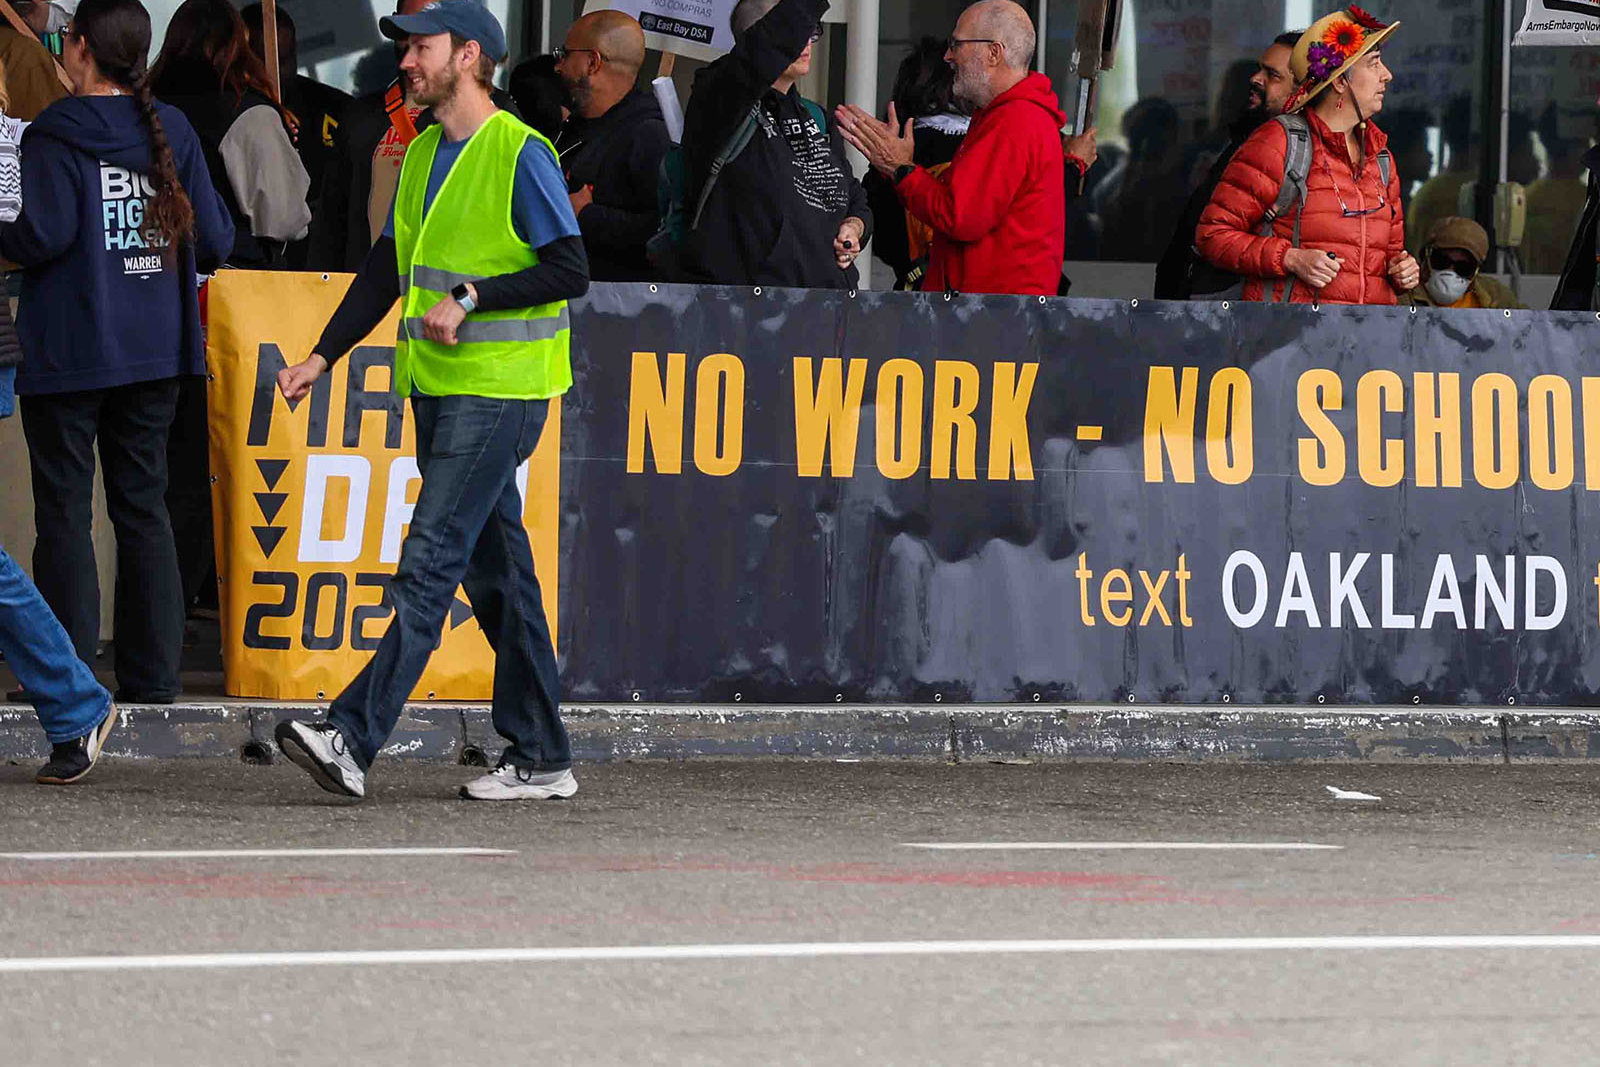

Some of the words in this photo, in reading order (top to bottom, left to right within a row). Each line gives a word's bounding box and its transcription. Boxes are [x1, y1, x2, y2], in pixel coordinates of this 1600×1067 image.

[656, 20, 673, 31] East
[675, 23, 690, 35] Bay
[690, 26, 708, 39] DSA
[667, 0, 712, 17] COMPRAS
[124, 256, 162, 271] WARREN
[246, 343, 404, 449] MA
[626, 351, 745, 476] NO
[793, 356, 1040, 481] WORK
[1143, 365, 1254, 485] NO
[1075, 551, 1193, 628] text
[1222, 550, 1568, 631] OAKLAND
